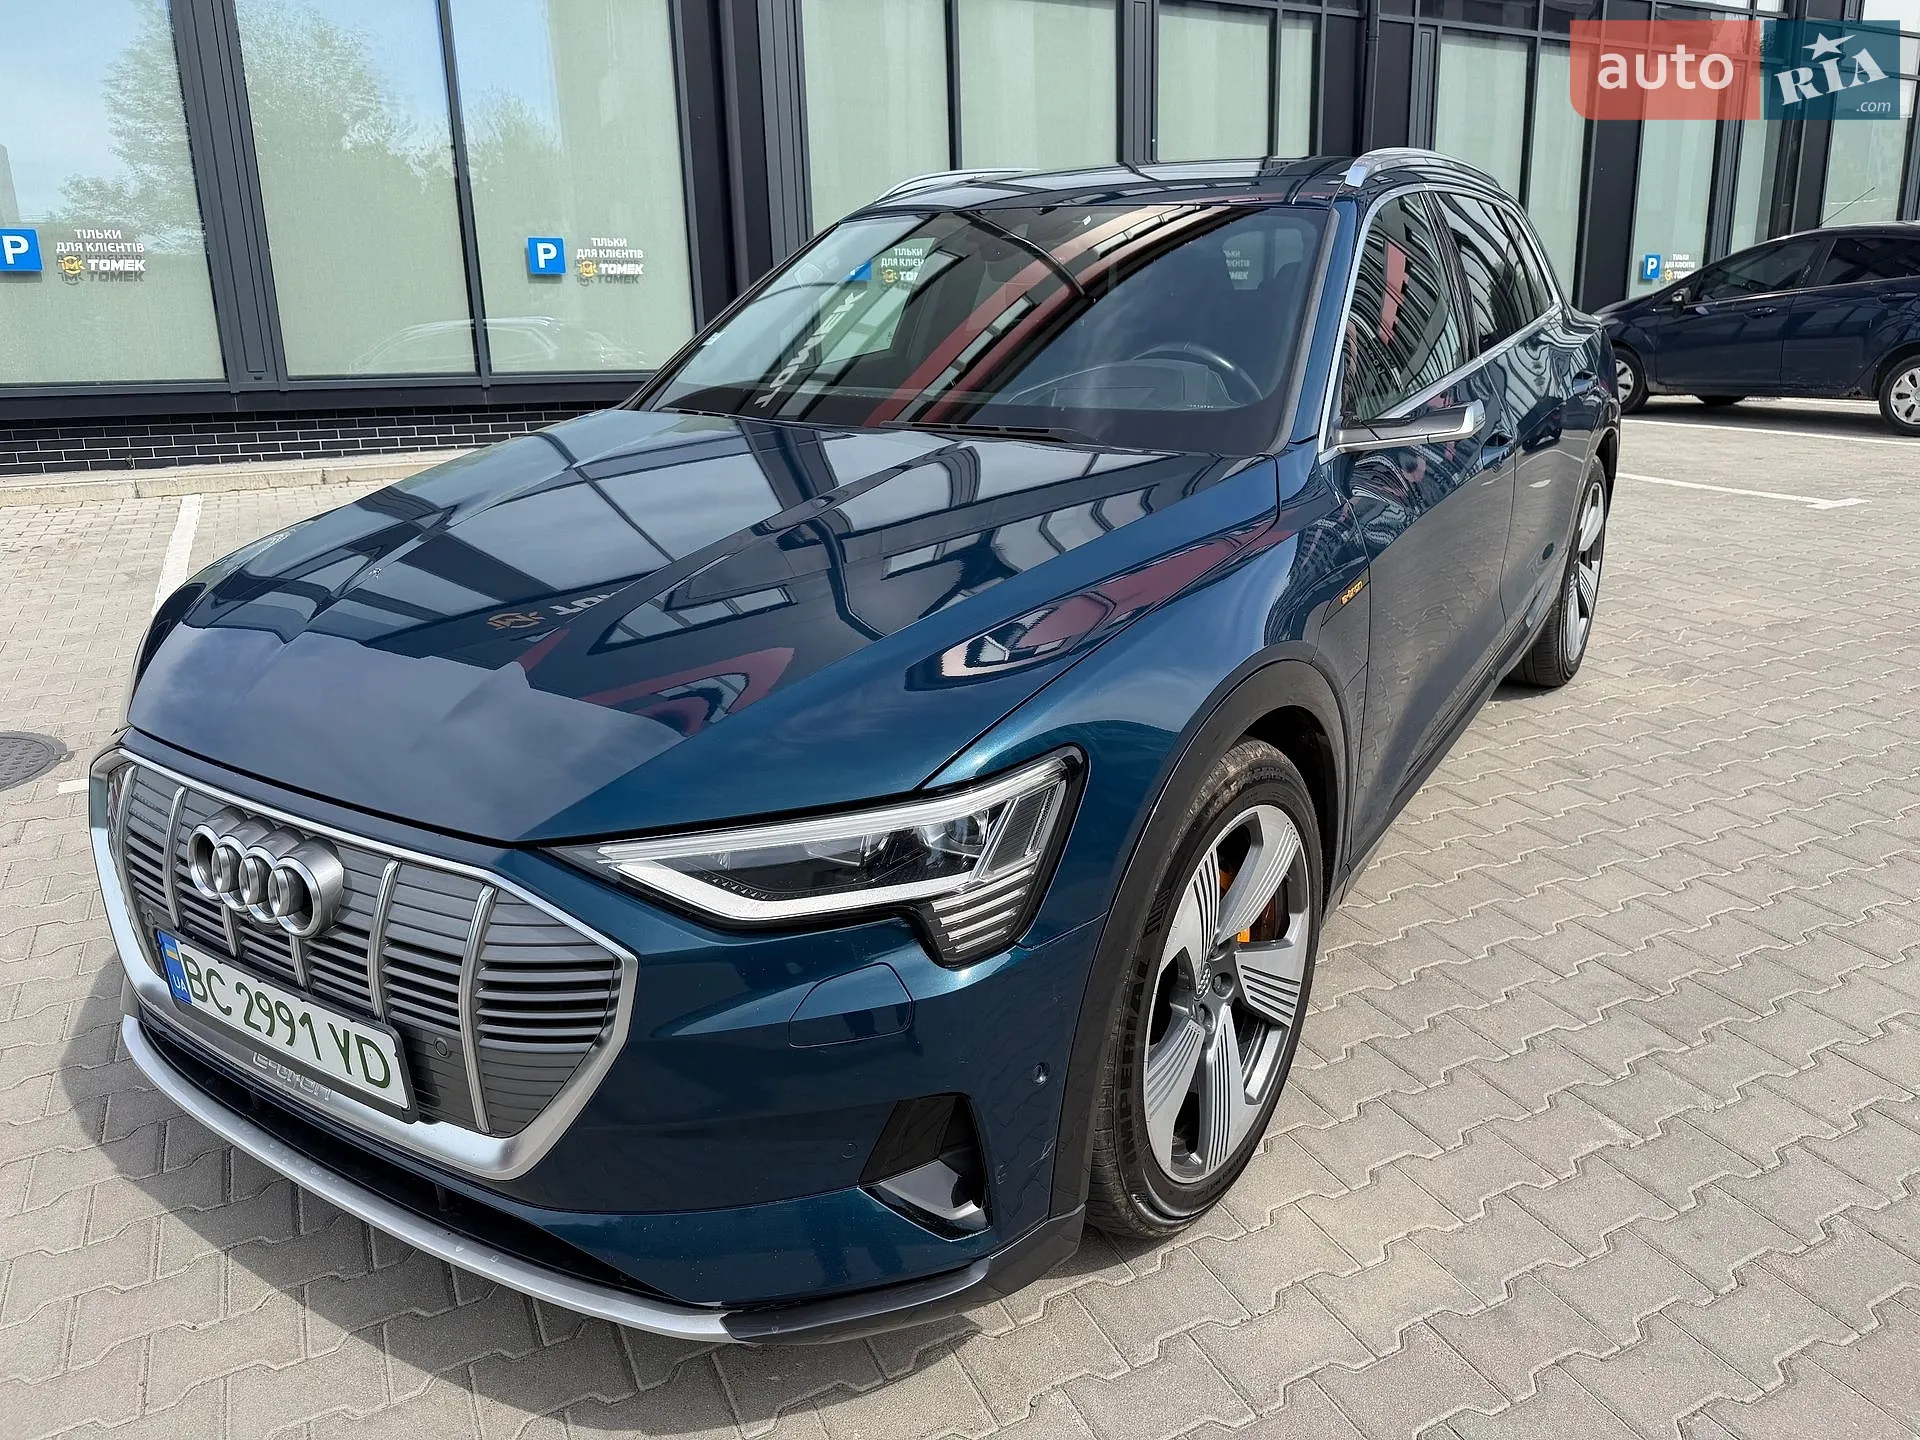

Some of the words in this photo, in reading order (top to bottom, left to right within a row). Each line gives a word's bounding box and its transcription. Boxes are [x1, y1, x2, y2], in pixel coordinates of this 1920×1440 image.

[74, 229, 122, 240] ТІЛЬКИ
[55, 241, 84, 253] ДЛЯ
[86, 242, 145, 253] КЛІЄНТІВ
[591, 237, 628, 247] ТІЛЬКИ
[2, 235, 29, 265] P
[536, 242, 558, 269] P
[576, 248, 598, 260] ДЛЯ
[599, 249, 645, 259] КЛІЄНТІВ
[899, 257, 925, 267] КЛІЄН
[173, 976, 189, 993] UA
[181, 953, 232, 1017] BC
[235, 981, 322, 1061] 2991
[327, 1021, 391, 1089] YD
